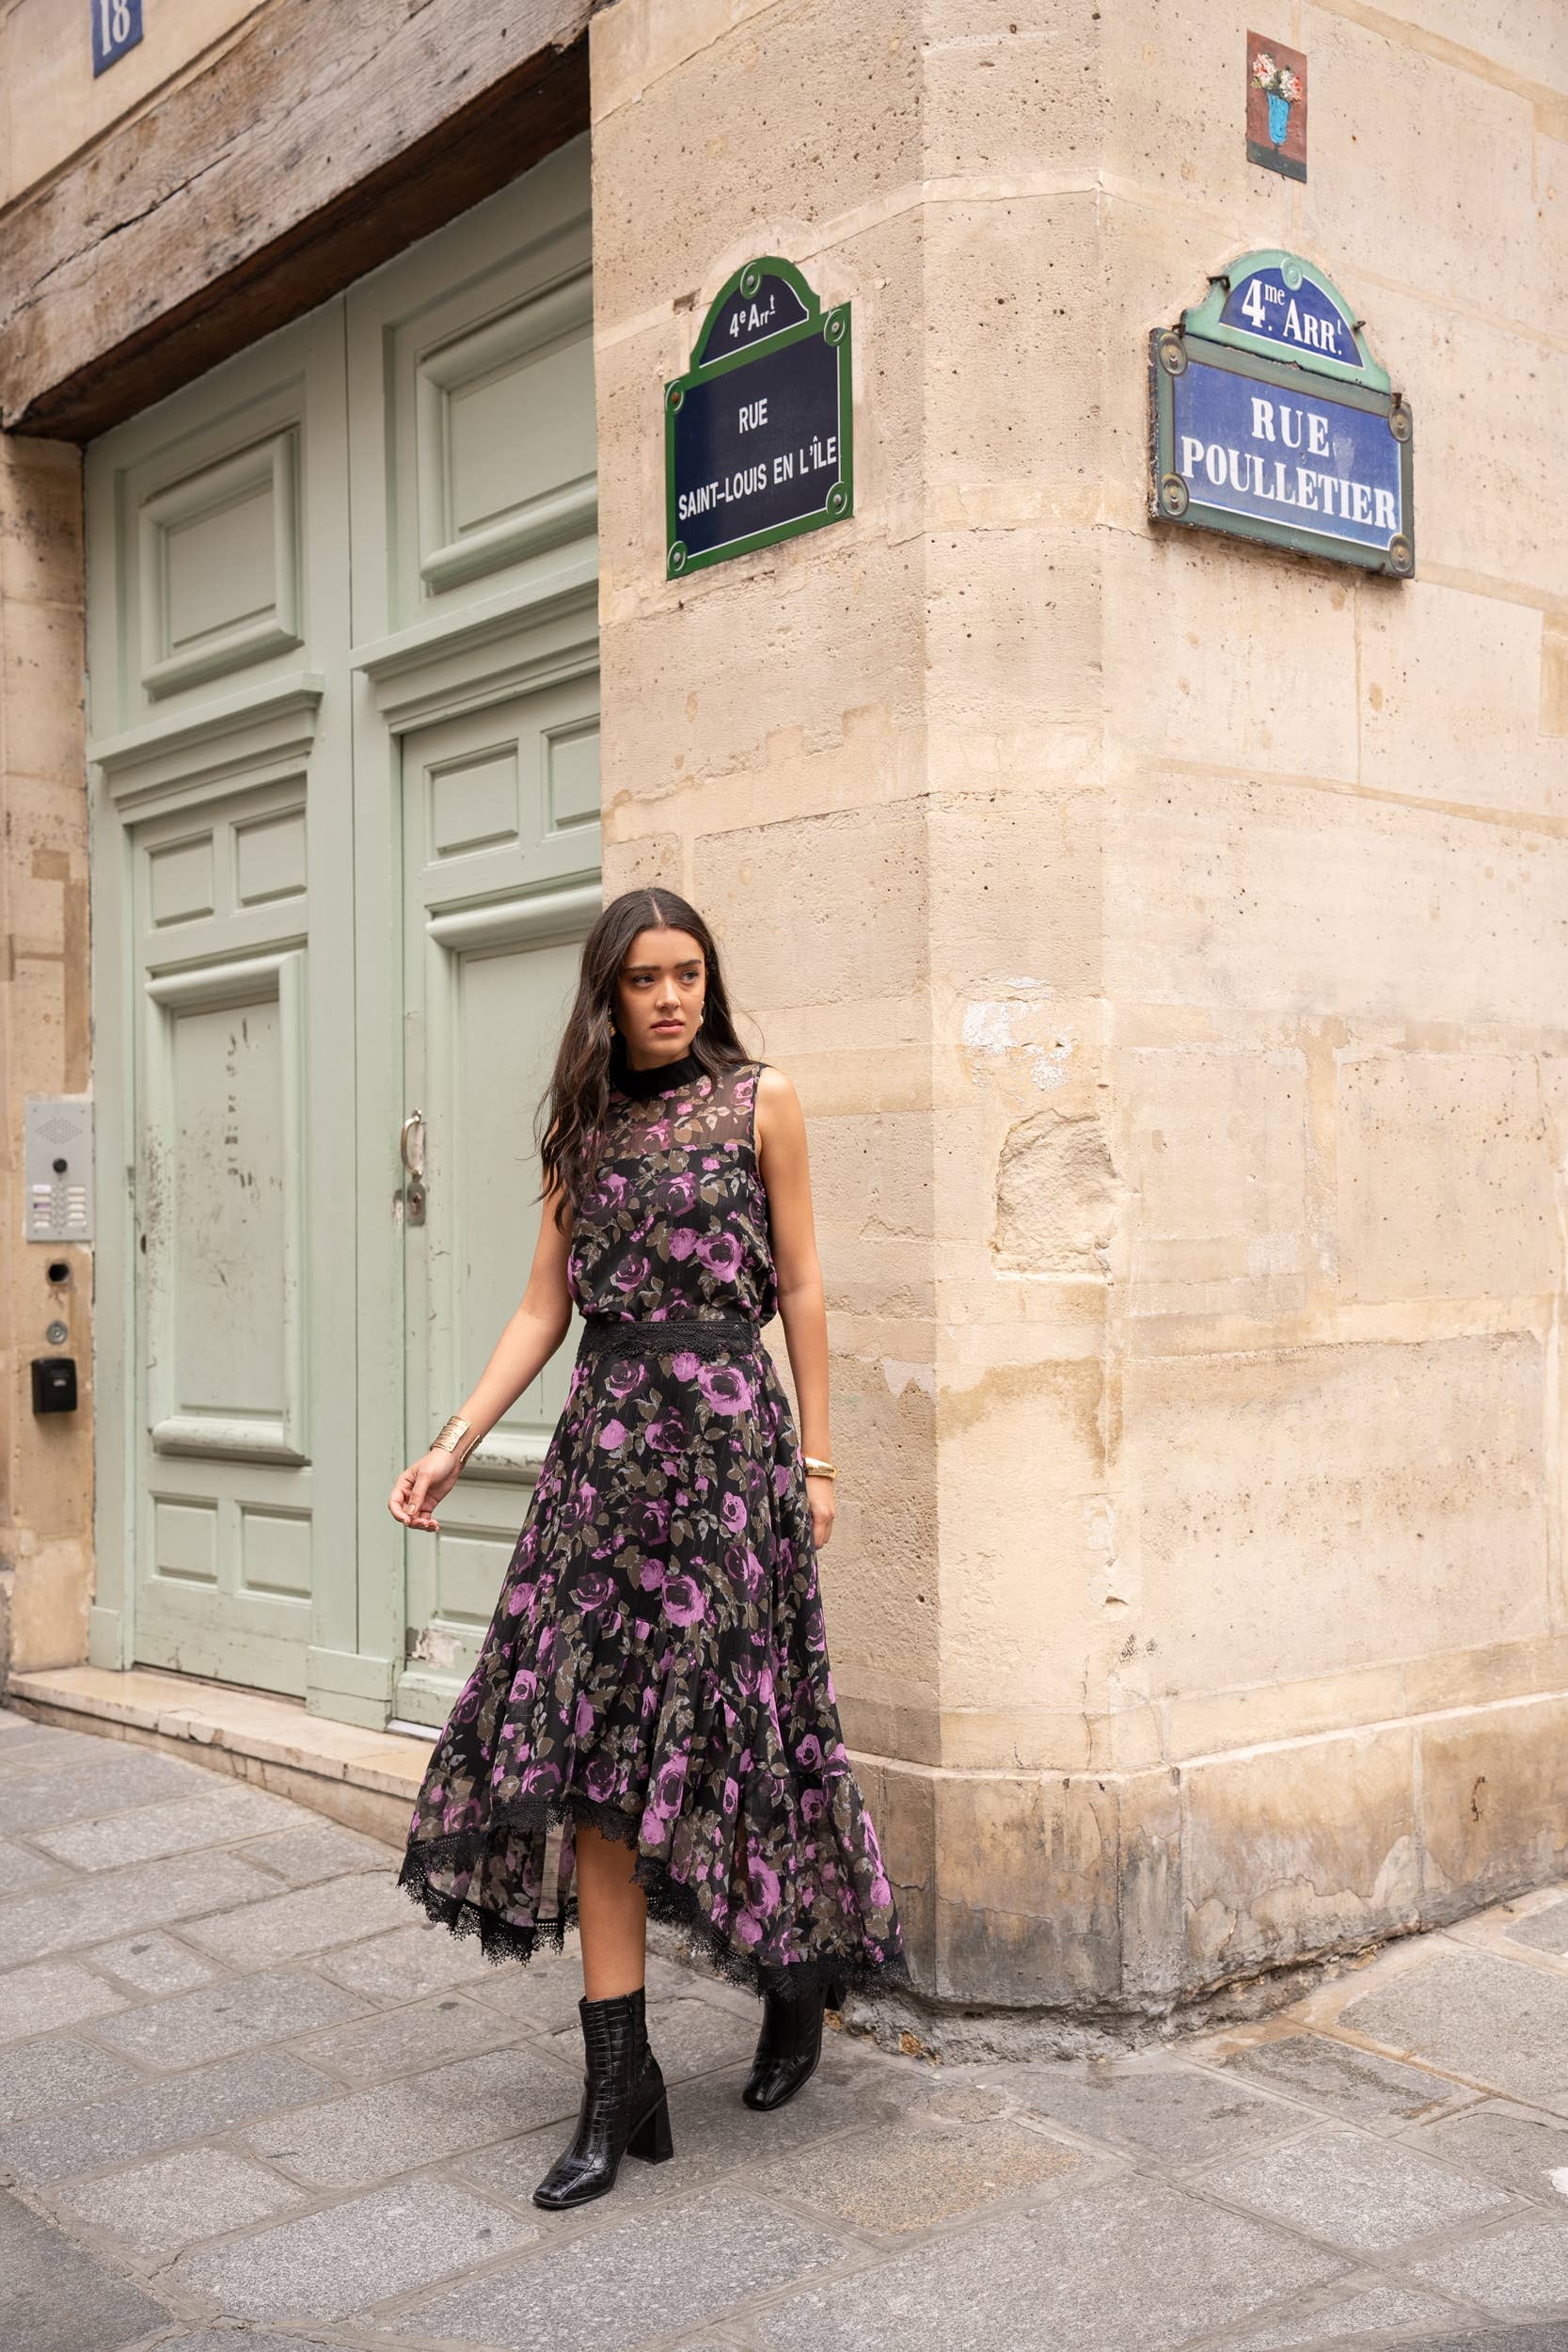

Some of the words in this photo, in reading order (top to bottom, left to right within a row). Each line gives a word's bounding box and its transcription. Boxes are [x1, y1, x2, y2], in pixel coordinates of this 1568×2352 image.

[101, 0, 131, 56] 18
[738, 398, 768, 434] RUE
[1251, 397, 1330, 457] RUE
[678, 464, 768, 520] SAINT-LOUIS
[773, 453, 794, 485] EN
[800, 436, 837, 475] L'ÎLE
[1180, 436, 1398, 530] POULLETIER
